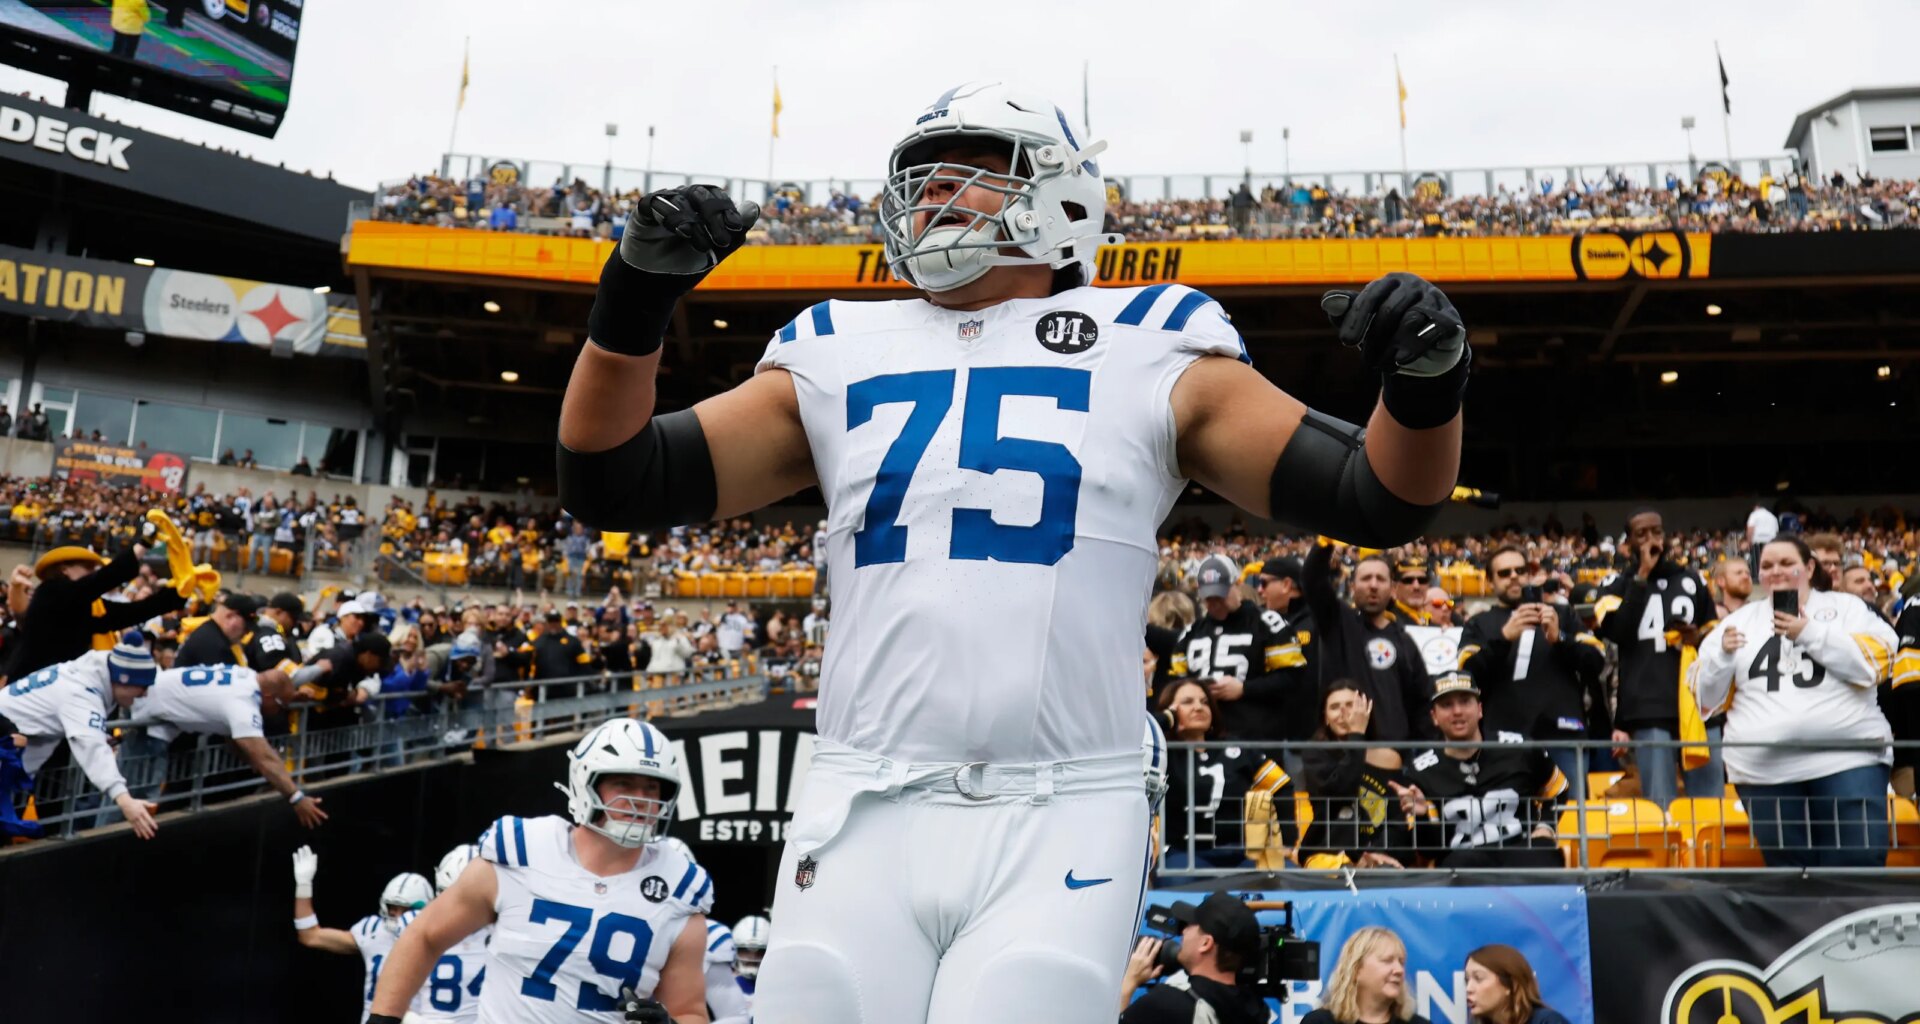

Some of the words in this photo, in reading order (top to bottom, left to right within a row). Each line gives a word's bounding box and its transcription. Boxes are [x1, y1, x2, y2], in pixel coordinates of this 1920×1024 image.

[0, 106, 133, 171] DECK
[916, 109, 949, 125] COLTS
[857, 250, 899, 282] TH
[1094, 247, 1182, 281] URGH
[170, 293, 230, 315] Steelers
[847, 367, 1092, 569] 75
[1187, 633, 1253, 684] 95
[521, 898, 654, 1011] 79
